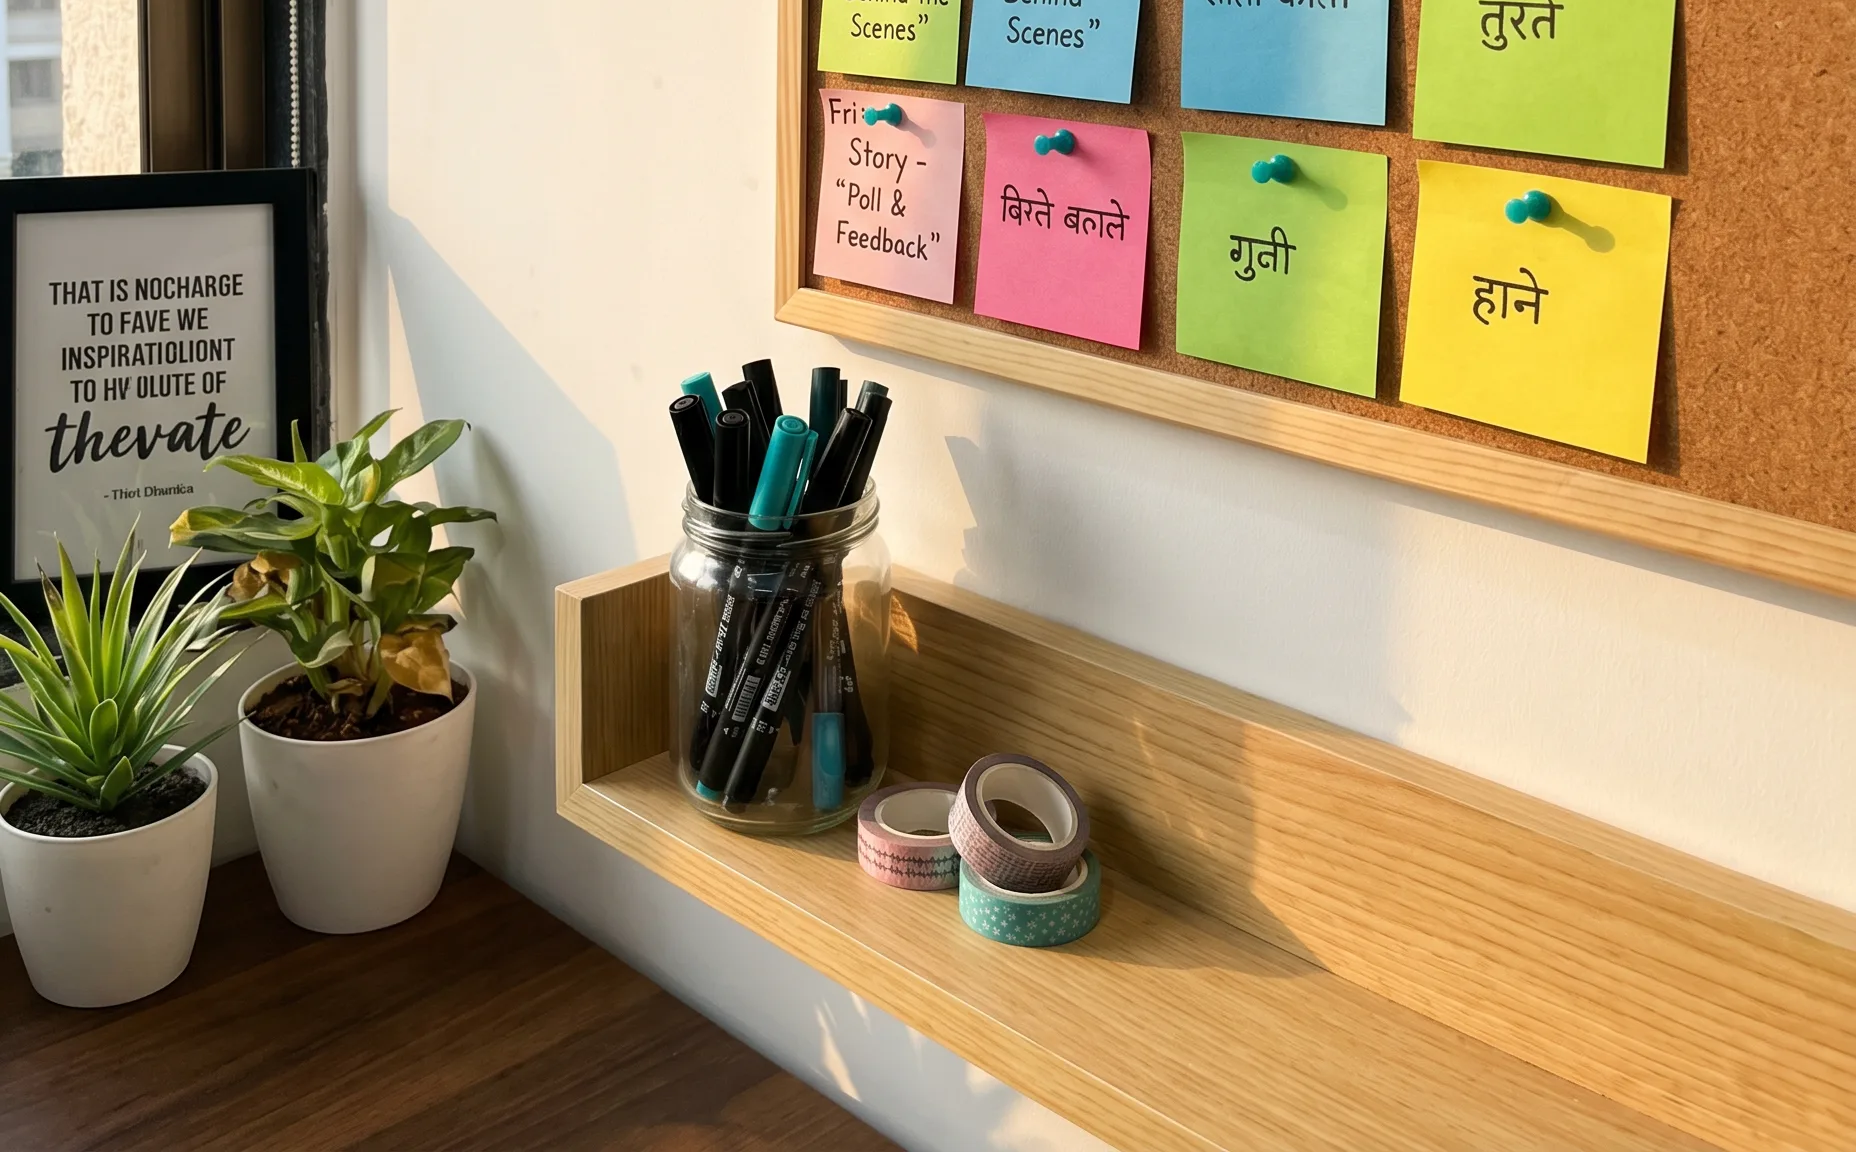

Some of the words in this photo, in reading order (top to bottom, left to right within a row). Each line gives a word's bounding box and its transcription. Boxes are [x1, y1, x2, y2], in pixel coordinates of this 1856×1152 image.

[851, 13, 928, 41] Scenes”
[1007, 16, 1100, 48] Scenes”
[849, 138, 907, 184] Story
[837, 178, 881, 212] “Poll
[891, 189, 906, 217] &
[837, 220, 940, 260] Feedback”
[49, 280, 104, 305] THAT
[110, 279, 128, 302] IS
[136, 274, 243, 301] NOCHARGE
[87, 312, 113, 336] TO
[121, 309, 170, 334] FAVE
[177, 308, 208, 330] WE
[70, 379, 96, 403] TO
[203, 371, 226, 394] OF
[45, 402, 250, 473] thevate
